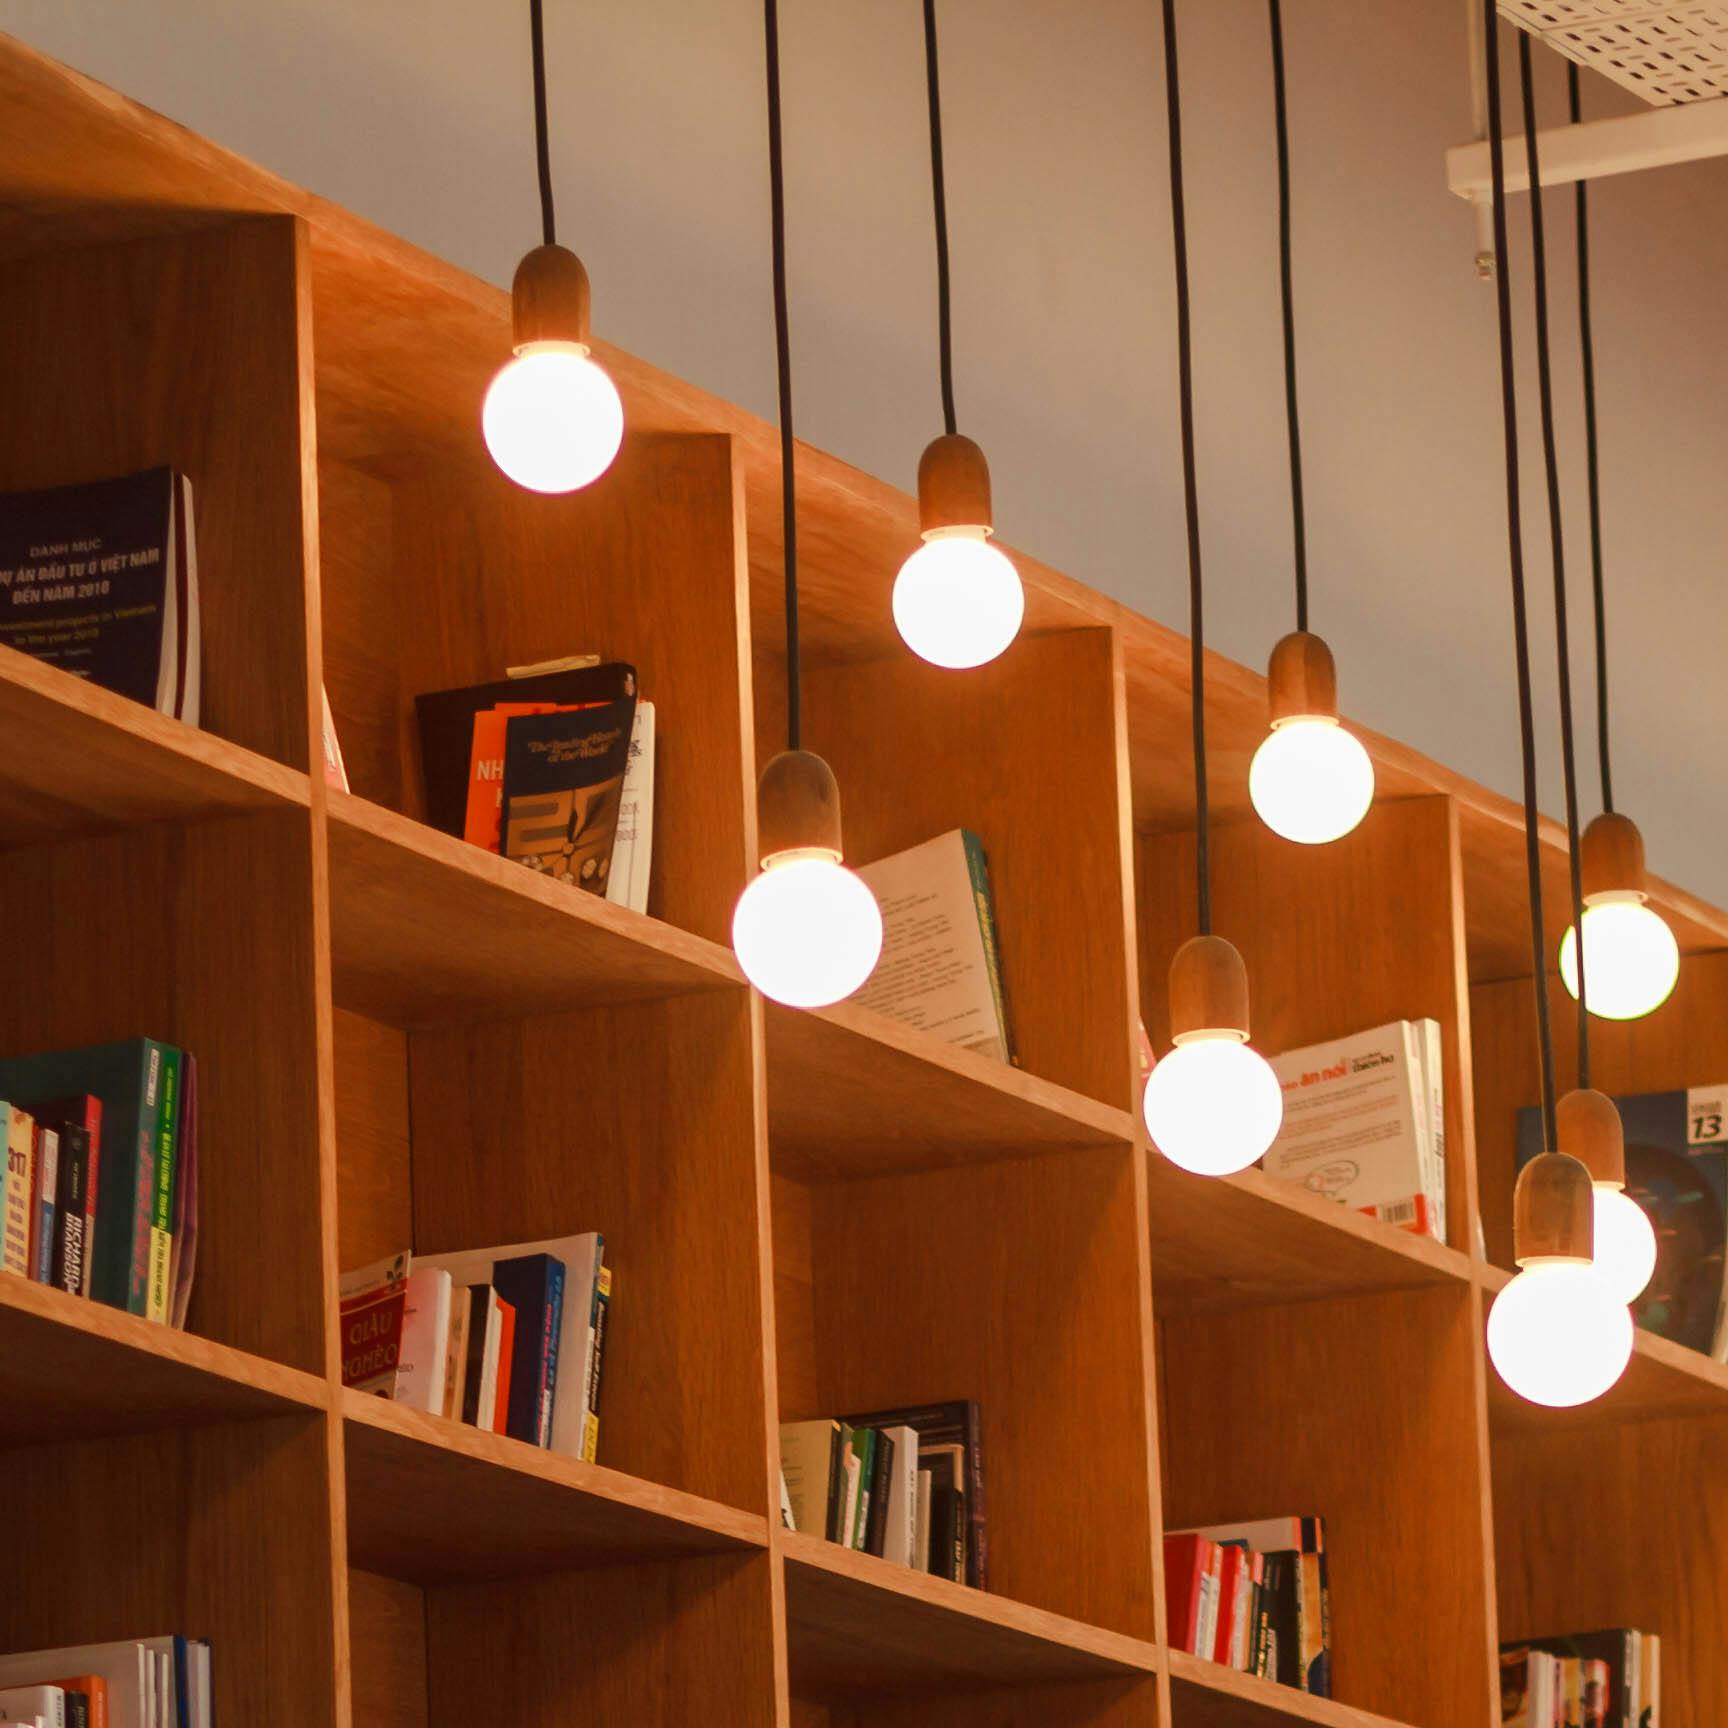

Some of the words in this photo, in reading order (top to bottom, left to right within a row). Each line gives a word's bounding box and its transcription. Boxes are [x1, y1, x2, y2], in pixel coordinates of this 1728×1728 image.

[129, 547, 160, 565] NAM
[1692, 1114, 1722, 1140] 13
[7, 1145, 27, 1178] 317
[72, 1213, 83, 1288] RICHARD
